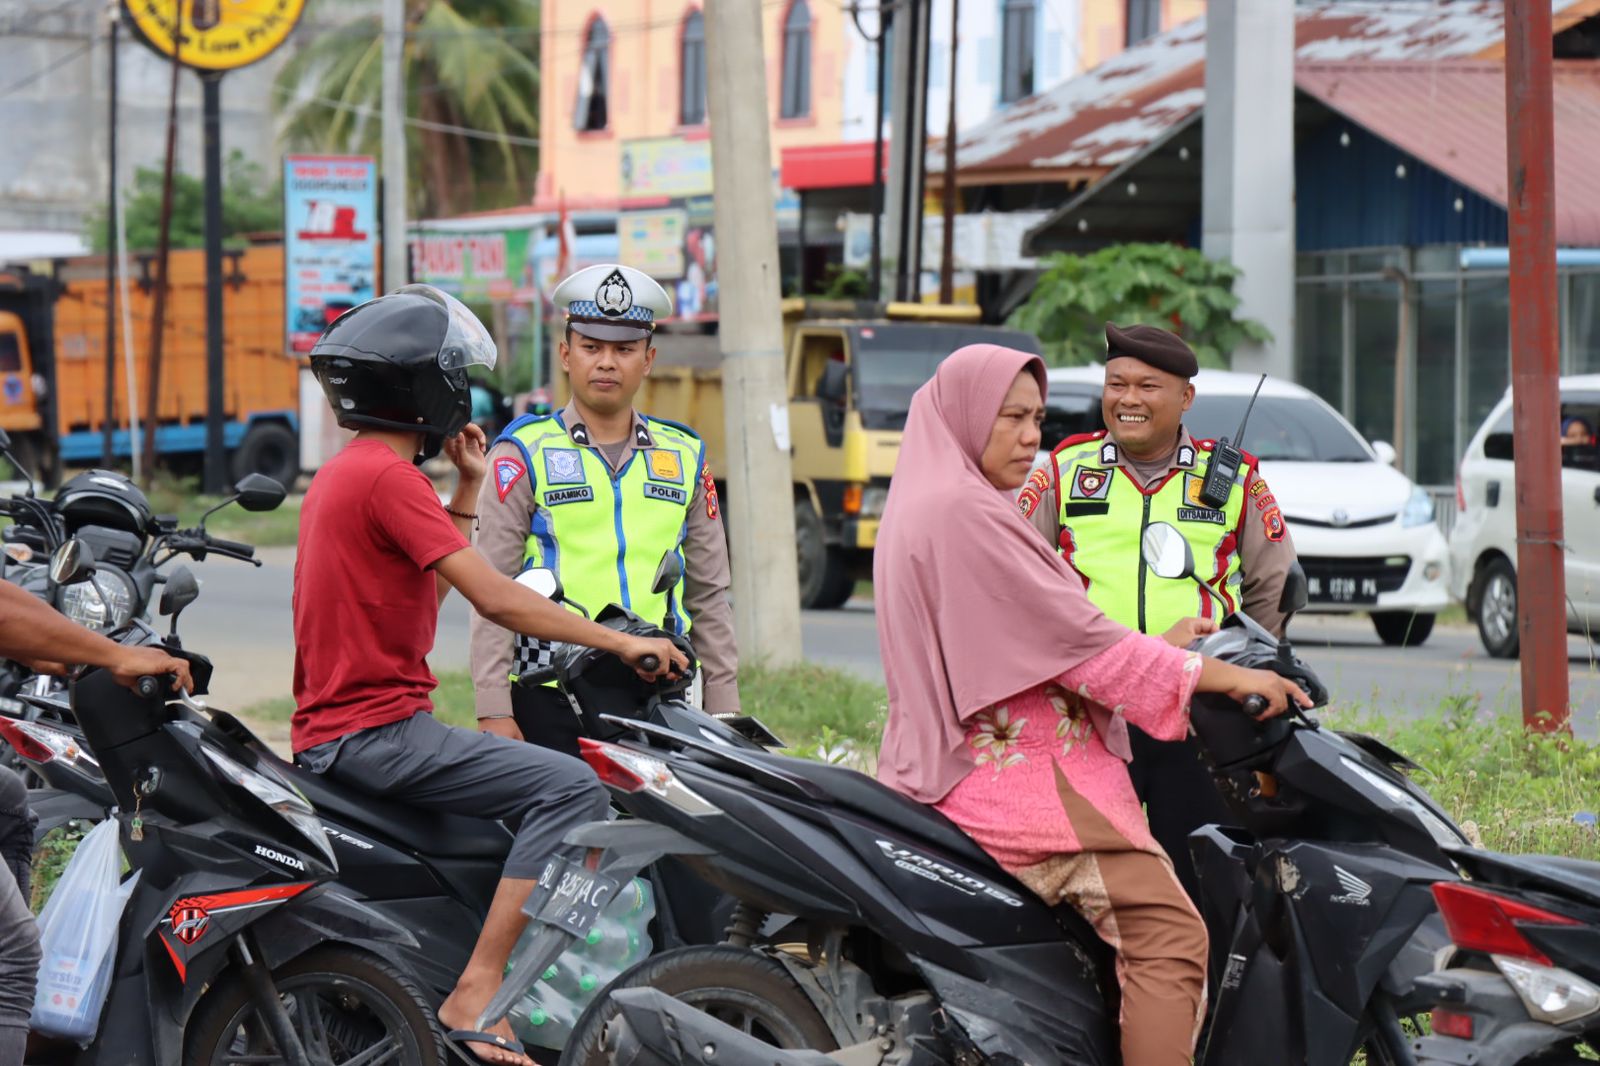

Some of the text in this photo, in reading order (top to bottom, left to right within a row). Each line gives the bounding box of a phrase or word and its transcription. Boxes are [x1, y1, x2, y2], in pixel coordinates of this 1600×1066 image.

[548, 489, 588, 502] ARAMIKO
[651, 486, 680, 500] POLRI
[1181, 510, 1224, 522] DITSAMAPTA
[255, 845, 305, 871] HONDA
[539, 863, 556, 889] BL
[567, 911, 586, 928] 21
